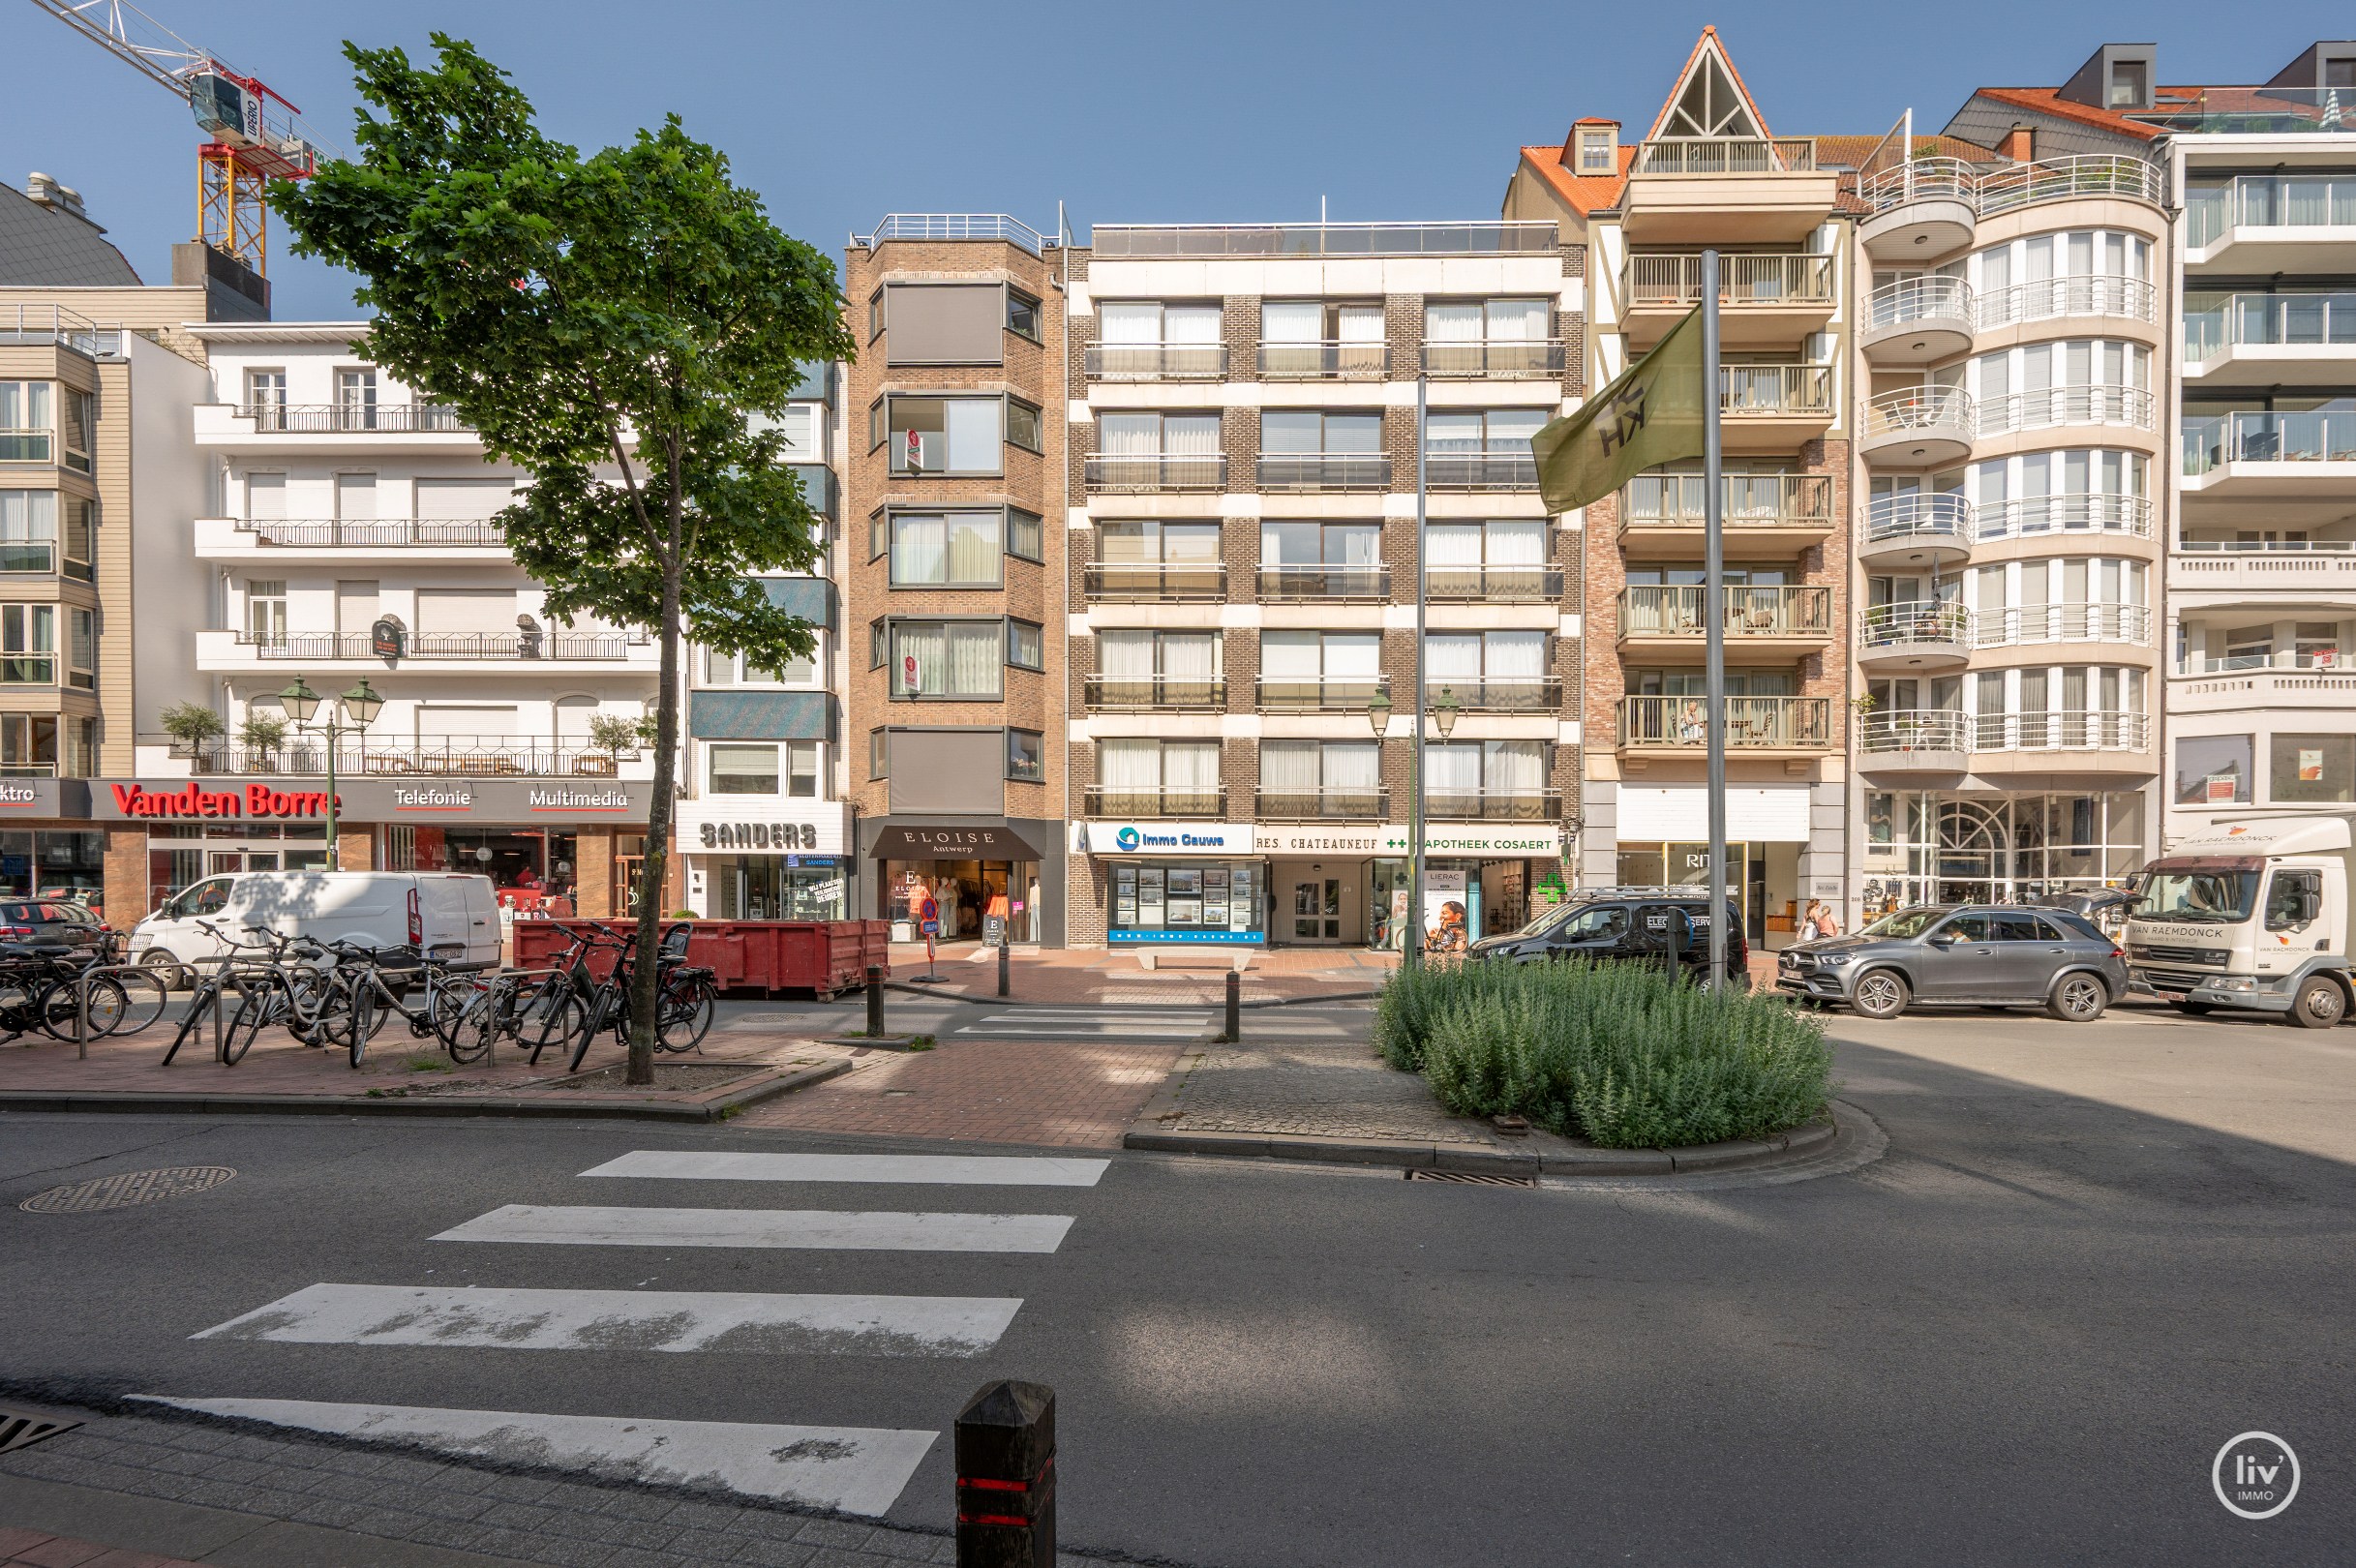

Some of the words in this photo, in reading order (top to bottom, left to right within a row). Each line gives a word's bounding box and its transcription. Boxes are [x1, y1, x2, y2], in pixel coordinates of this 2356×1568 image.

[248, 100, 257, 136] UPERIO
[0, 785, 35, 801] ktro
[109, 782, 239, 816] Vanden
[246, 783, 341, 816] Borre
[394, 789, 471, 805] Telefonie
[529, 790, 629, 806] Multimedia
[700, 823, 816, 846] SANDERS
[904, 832, 994, 843] ELOISE
[1143, 833, 1178, 847] Immo
[1182, 833, 1224, 847] Cauwe
[933, 845, 973, 854] Antwerp
[1255, 838, 1282, 849] RES.
[1290, 838, 1377, 850] CHATEAUNEUF
[1424, 839, 1491, 850] APOTHEEK
[1494, 840, 1552, 850] COSAERT
[2152, 926, 2223, 938] RAEMDONCK
